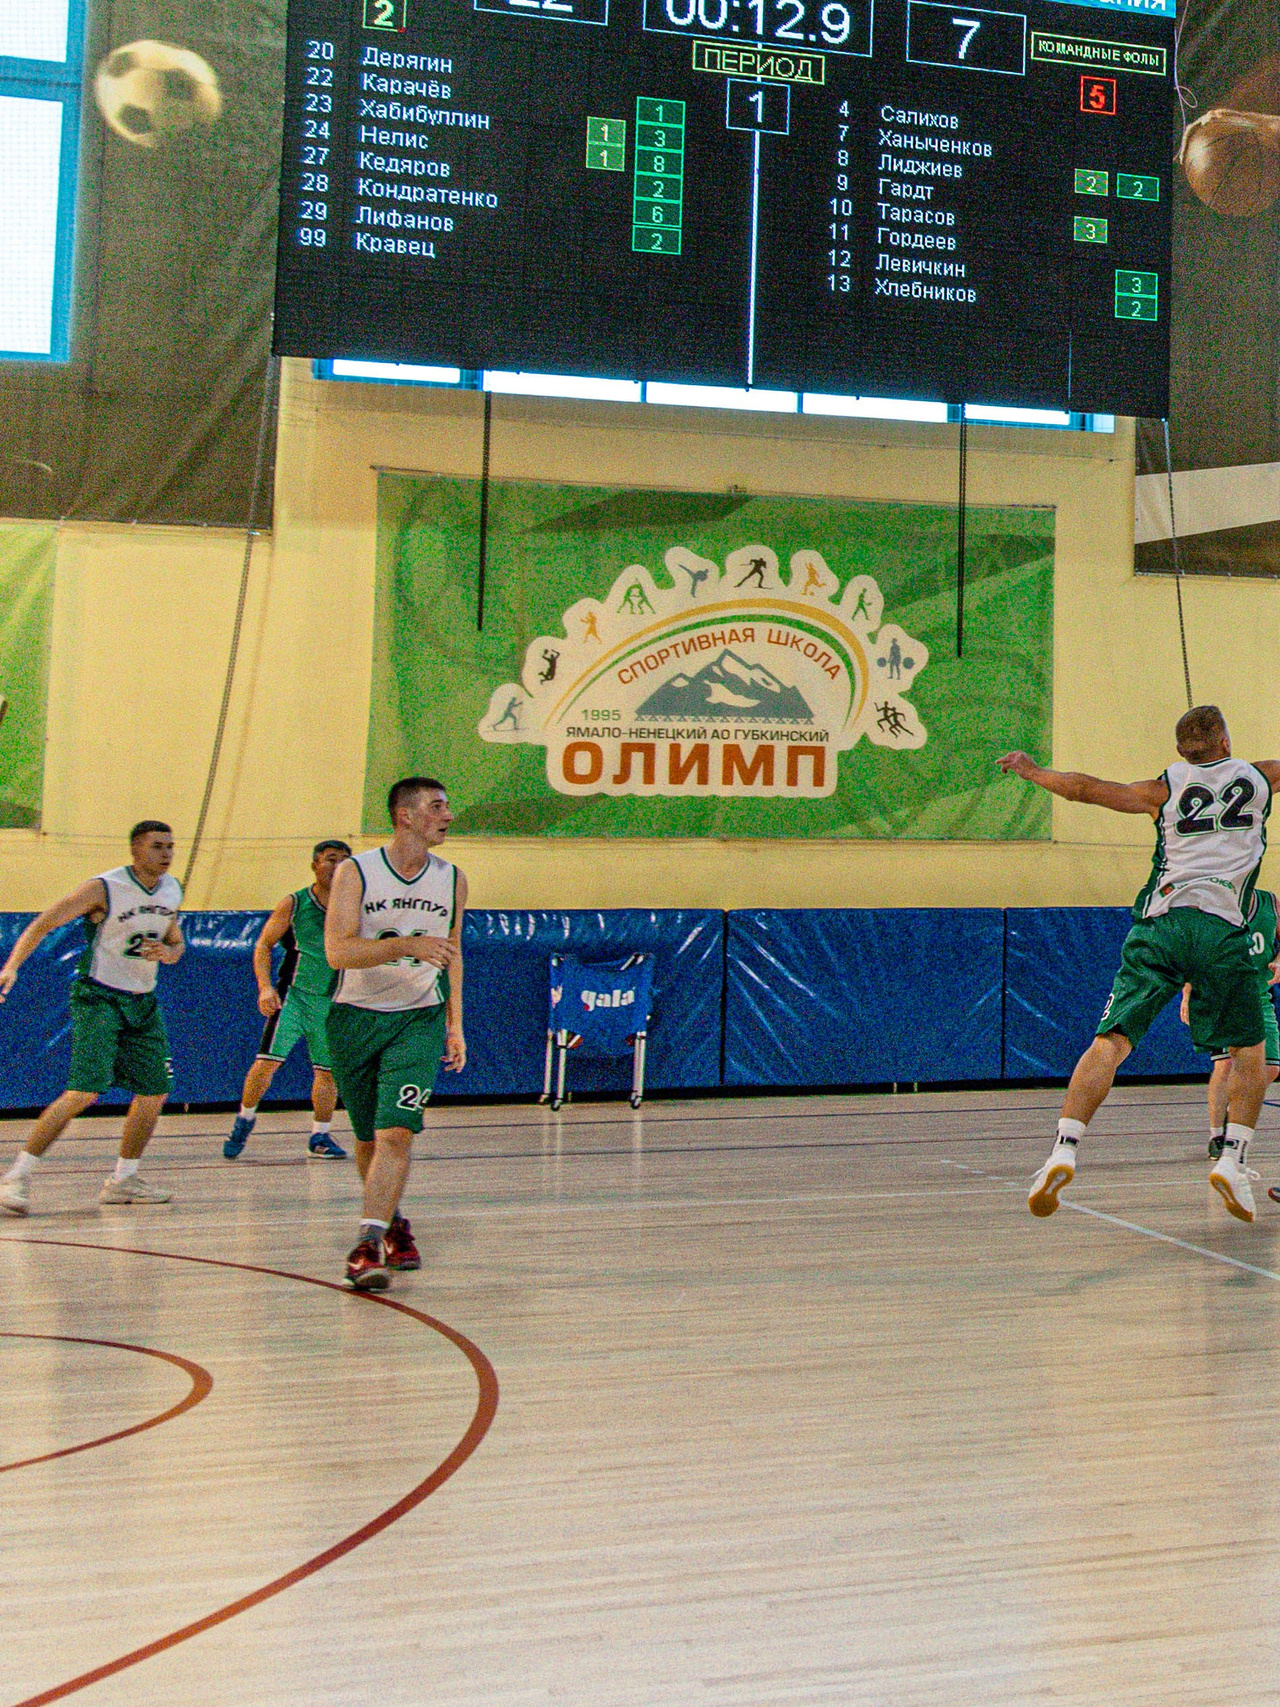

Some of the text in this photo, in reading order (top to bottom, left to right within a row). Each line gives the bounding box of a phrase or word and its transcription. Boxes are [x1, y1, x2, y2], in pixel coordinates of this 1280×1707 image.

[374, 0, 394, 27] 2
[952, 18, 980, 60] 7
[308, 40, 452, 74] 20 Дерягин
[704, 48, 813, 82] ПЕРИОД
[1038, 40, 1159, 66] КОМАНДНЫЕ ФОЛЫ
[306, 67, 451, 99] 22 Карачёв
[1089, 84, 1105, 109] 5
[305, 93, 490, 130] 23 Хабибуллин
[656, 105, 663, 122] 1
[749, 91, 763, 122] 1
[839, 100, 959, 129] 4 Салихов
[304, 120, 429, 149] 24 Нелис
[601, 124, 608, 142] 1
[655, 130, 665, 147] 3
[838, 124, 993, 157] 7 Ханыченков
[303, 146, 451, 178] 27 Кедяров
[600, 150, 607, 167] 1
[654, 155, 664, 173] 8
[837, 150, 963, 179] 8 Лиджиев
[302, 173, 498, 209] 28 Кондратенко
[653, 180, 664, 198] 2
[837, 174, 934, 200] 9 Гардт
[1087, 176, 1097, 193] 2
[1133, 181, 1143, 197] 2
[300, 201, 454, 232] 29 Лифанов
[652, 206, 663, 223] 6
[830, 198, 955, 226] 10 Тарасов
[299, 227, 436, 259] 99 Кравец
[651, 233, 662, 250] 2
[829, 223, 956, 250] 11 Гордеев
[1086, 223, 1096, 240] 3
[828, 249, 965, 278] 12 Левичкин
[828, 274, 977, 303] 13 Хлебников
[1132, 277, 1142, 294] 3
[1131, 301, 1141, 317] 2
[617, 627, 841, 685] СПОРТИВНАЯ ШКОЛА
[581, 709, 620, 721] 1995
[566, 725, 829, 742] ЯМАЛО-НЕНЕЦКИЙ АО ГУБКИНСКИЙ
[562, 741, 826, 787] ОЛИМП
[1175, 777, 1257, 837] 22
[581, 990, 635, 1011] gala
